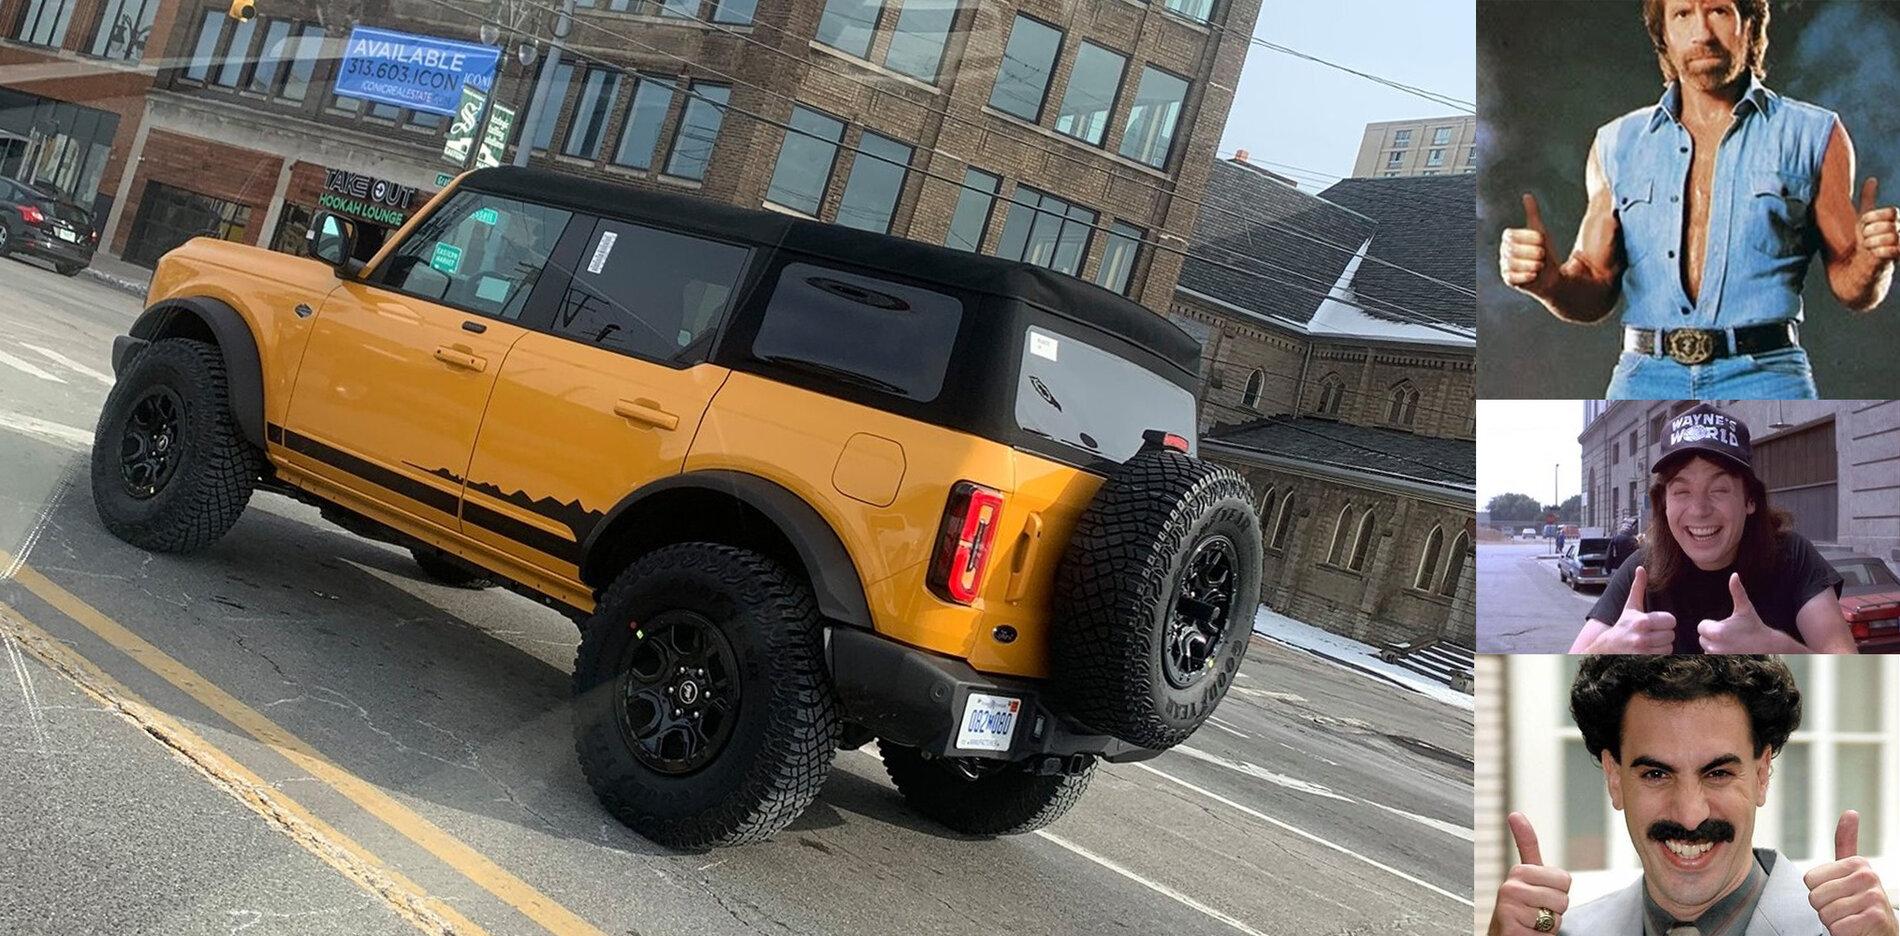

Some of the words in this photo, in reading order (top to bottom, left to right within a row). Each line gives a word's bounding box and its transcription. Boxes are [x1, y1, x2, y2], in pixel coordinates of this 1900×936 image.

[354, 38, 466, 72] AVAILABLE
[347, 57, 460, 91] 313.603.ICON
[324, 167, 371, 198] TAKE
[371, 177, 415, 209] OUT
[319, 193, 362, 215] HOOKAH
[362, 204, 404, 226] LOUNGE
[1670, 424, 1739, 447] WORLD
[1671, 413, 1737, 433] WAYNE'S
